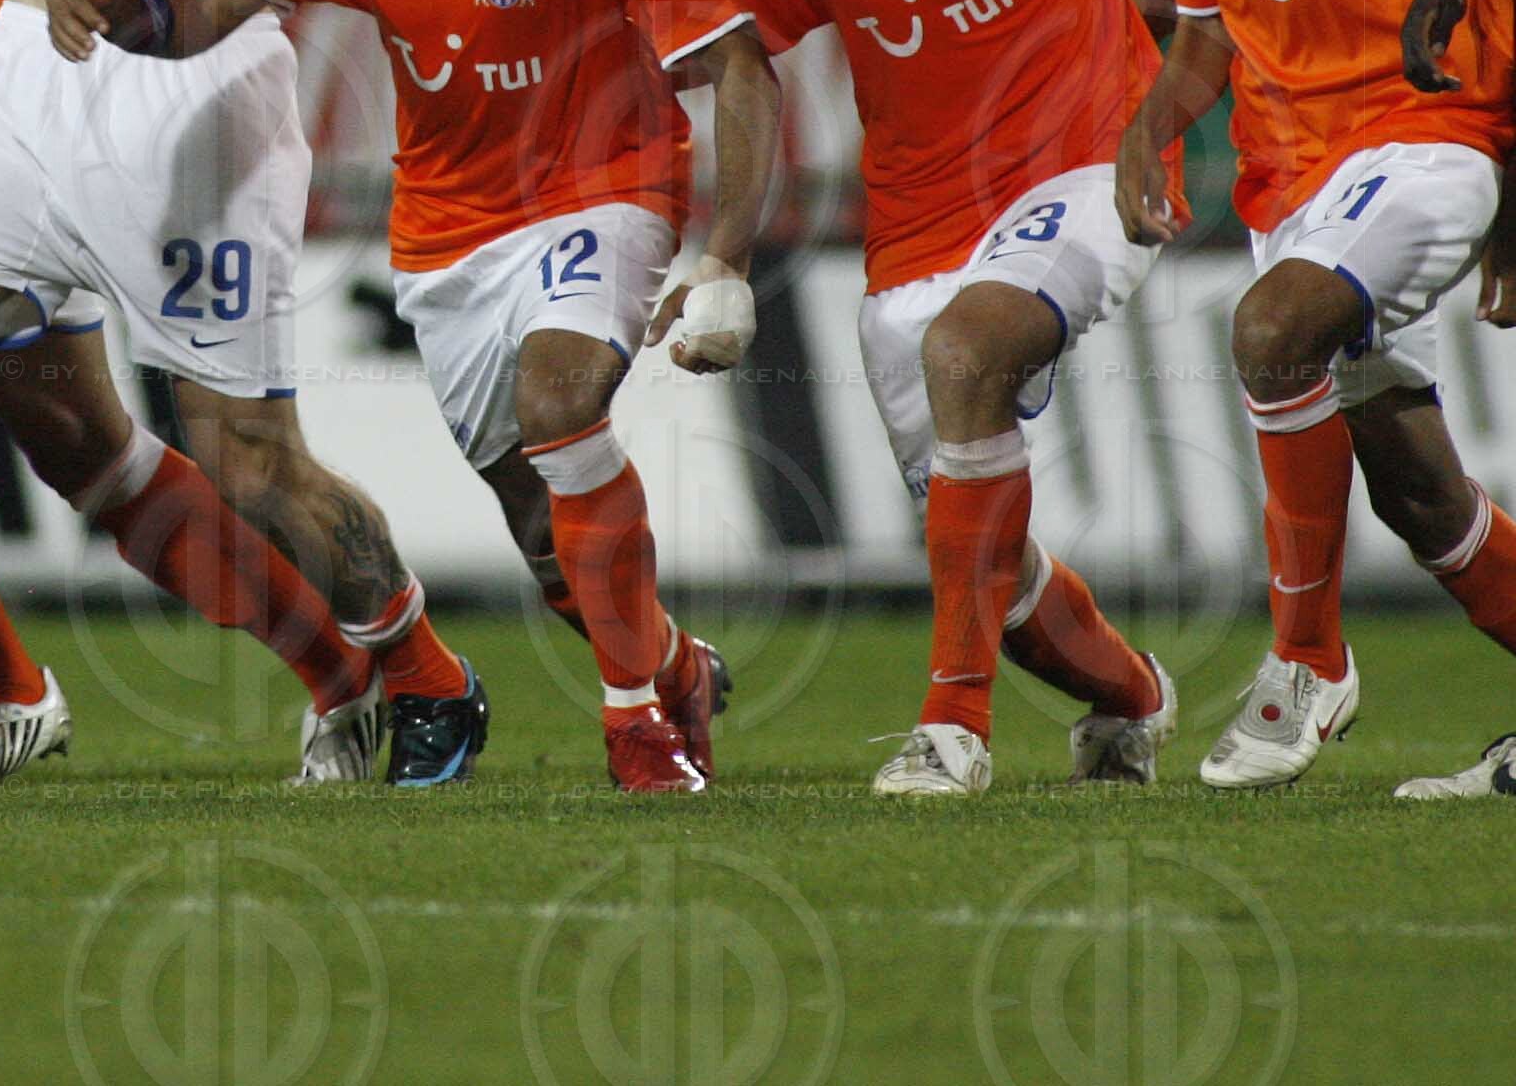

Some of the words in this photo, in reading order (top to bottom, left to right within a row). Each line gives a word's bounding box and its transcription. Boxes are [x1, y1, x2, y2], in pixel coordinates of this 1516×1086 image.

[474, 55, 543, 93] TUI
[1324, 174, 1389, 222] 1
[160, 237, 253, 322] 29
[537, 227, 602, 291] 12
